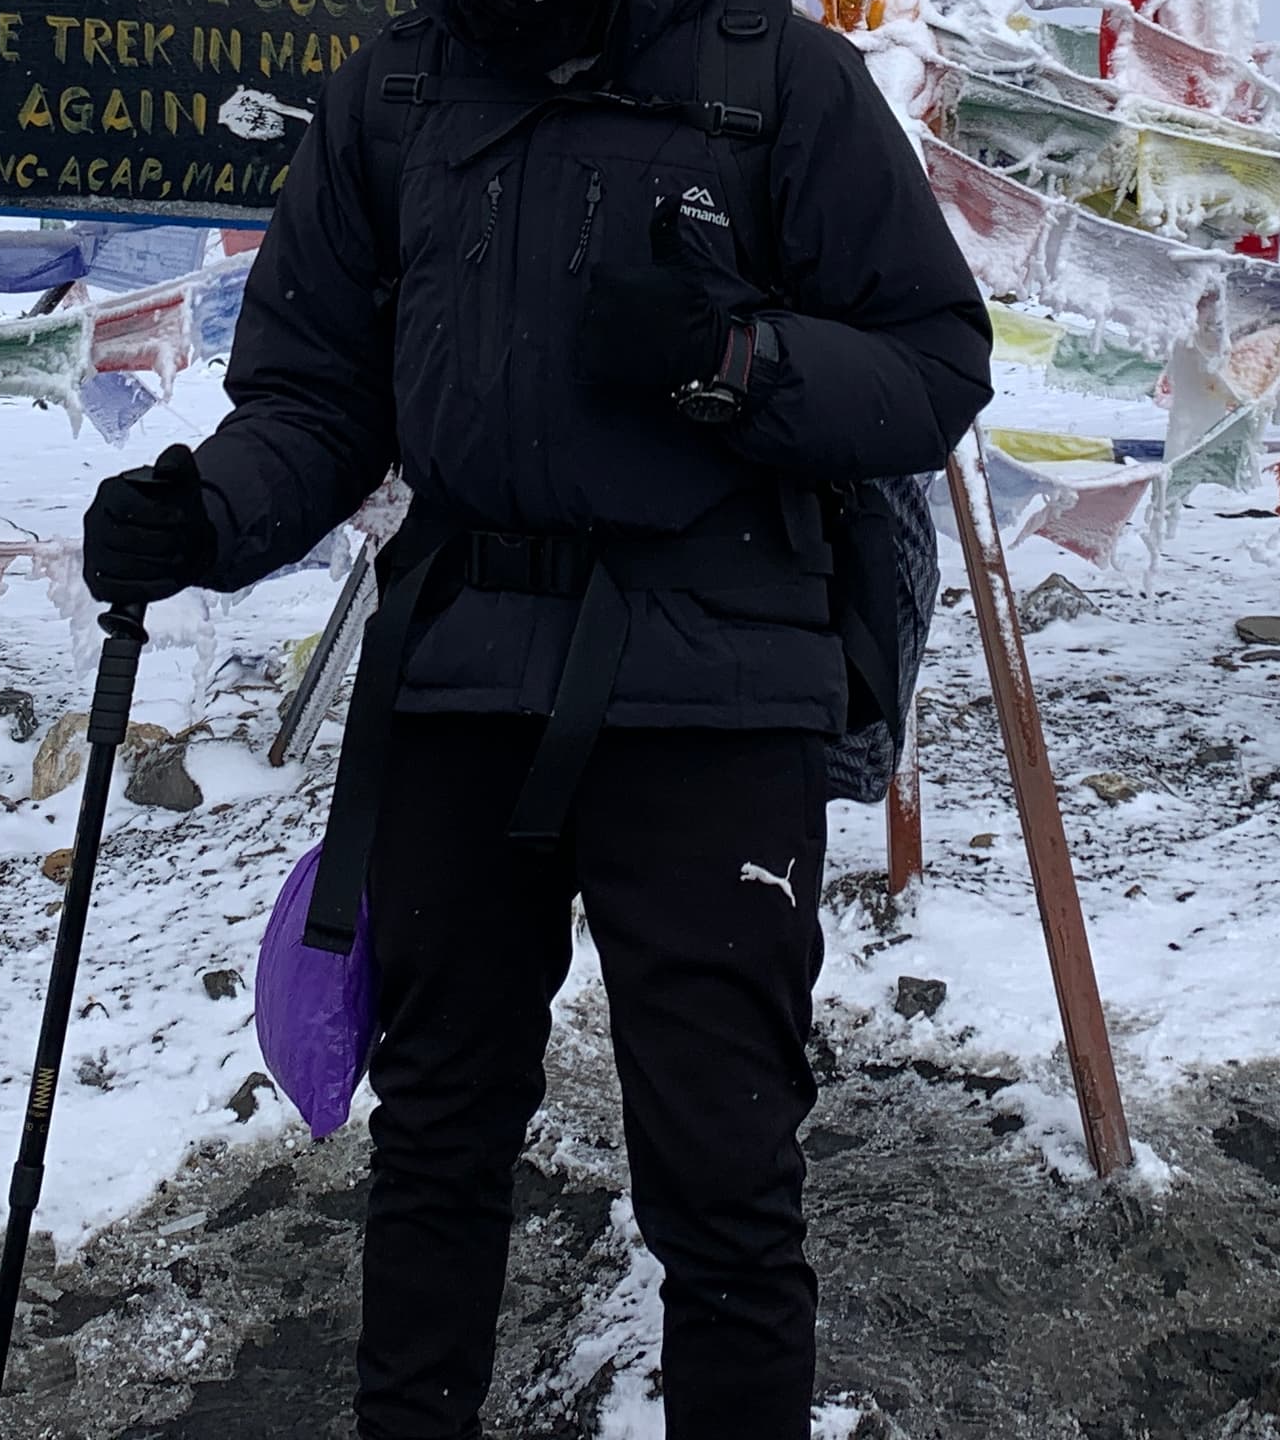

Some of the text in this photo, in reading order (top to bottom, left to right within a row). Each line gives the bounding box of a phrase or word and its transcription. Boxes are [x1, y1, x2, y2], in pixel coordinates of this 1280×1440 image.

[45, 15, 177, 75] TREK
[192, 27, 242, 75] IN
[19, 82, 207, 139] AGAIN
